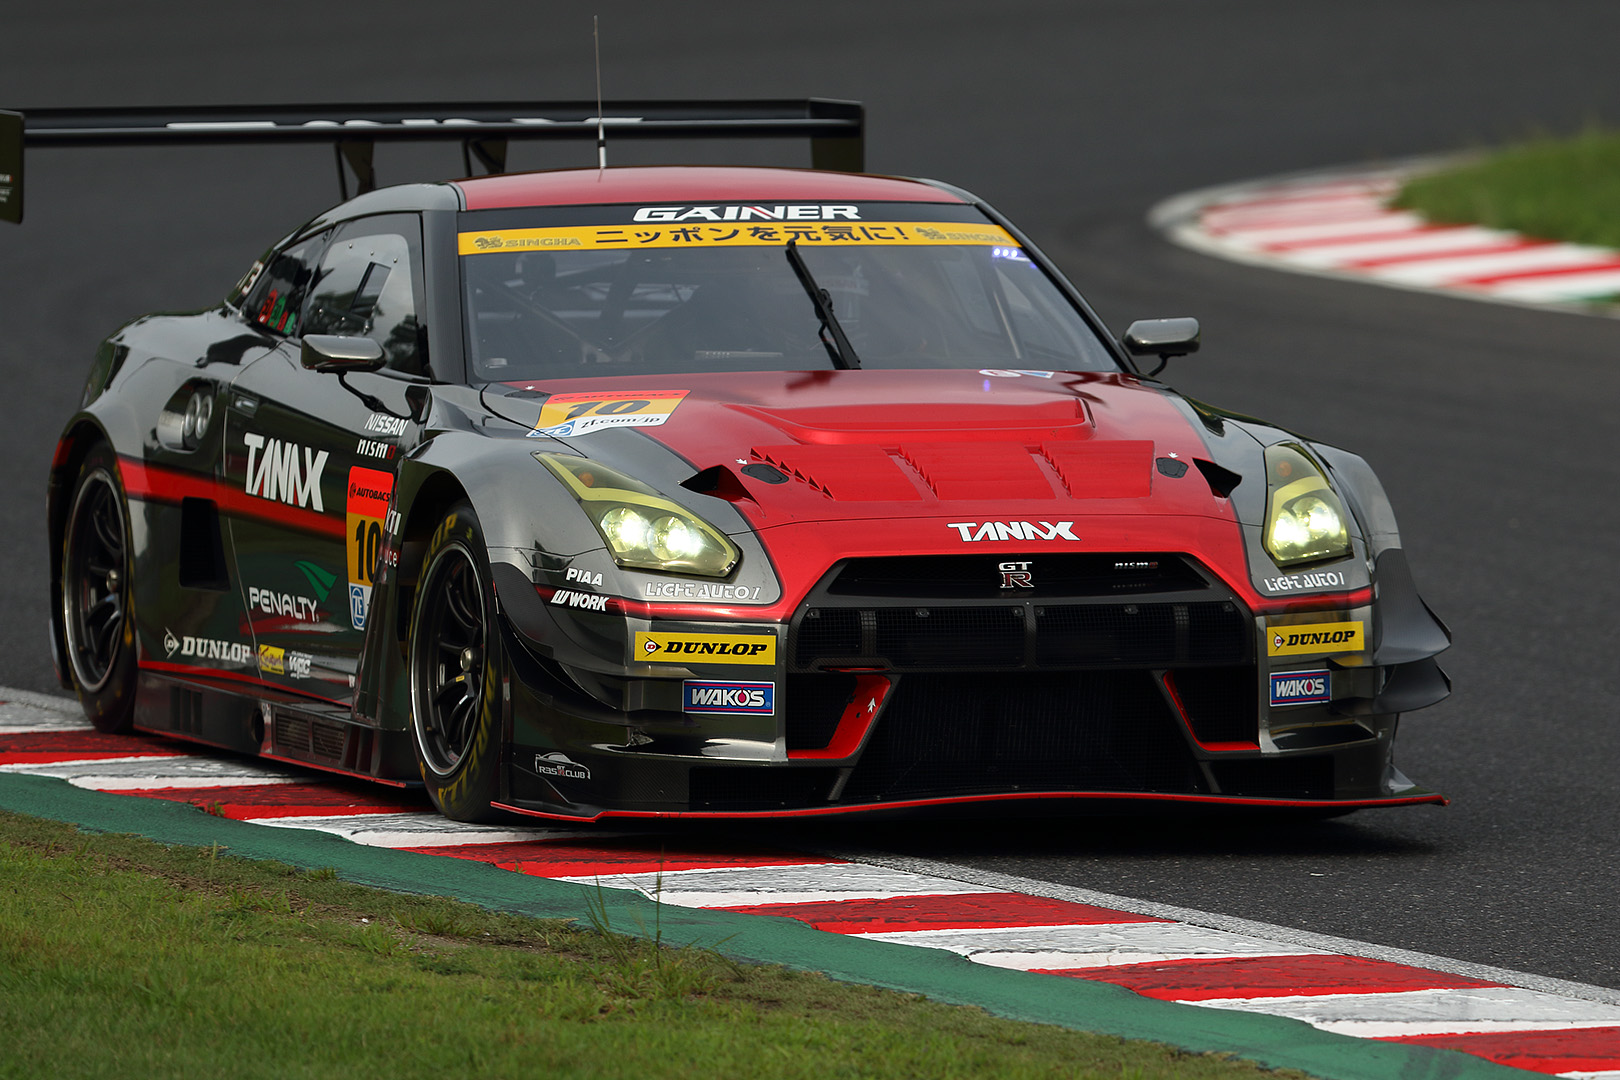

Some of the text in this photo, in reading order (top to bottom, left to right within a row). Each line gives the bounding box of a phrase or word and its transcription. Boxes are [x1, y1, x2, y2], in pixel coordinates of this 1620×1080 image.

[632, 205, 862, 222] GAINER
[504, 236, 582, 248] SINGHA
[565, 400, 651, 421] 10
[364, 413, 408, 436] NISSAN
[581, 416, 661, 429] zf.com/jp
[244, 432, 329, 512] TANAX
[356, 487, 391, 503] AUTOBACS
[946, 521, 1081, 542] TANAX
[356, 520, 382, 584] 10
[998, 562, 1033, 571] GT
[566, 568, 603, 586] PIAA
[1000, 571, 1035, 588] R
[249, 586, 317, 622] PENALTY
[1287, 631, 1355, 646] DUNLOP
[181, 636, 250, 664] DUNLOP
[664, 641, 767, 656] DUNLOP
